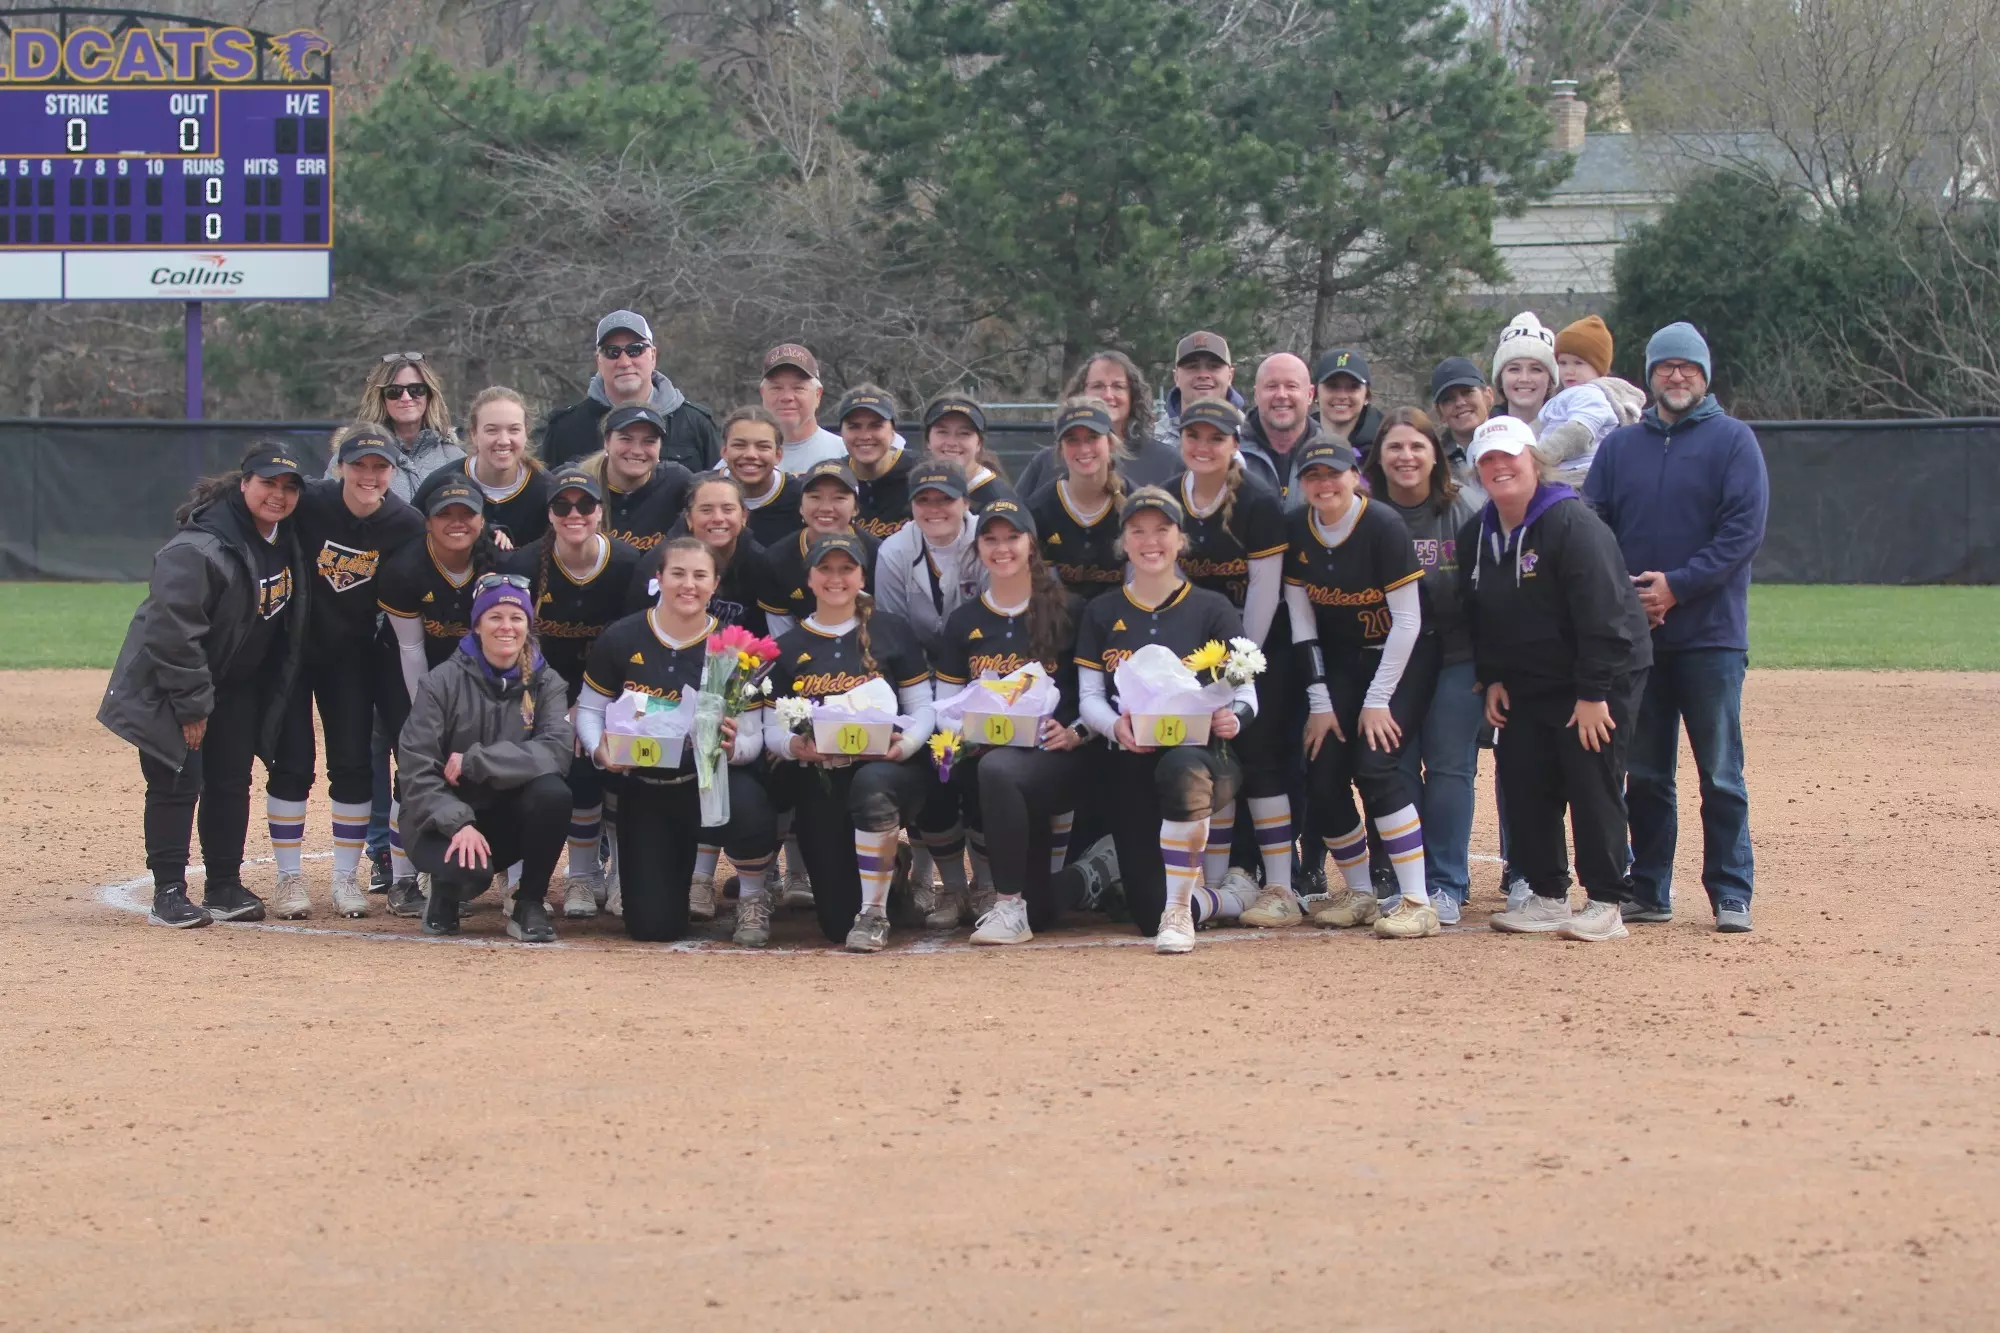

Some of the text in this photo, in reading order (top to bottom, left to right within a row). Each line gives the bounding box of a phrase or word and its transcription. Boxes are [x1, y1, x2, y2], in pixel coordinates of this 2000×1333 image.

[0, 26, 258, 82] DCATS
[46, 94, 319, 116] STRIKE OUT H/E
[67, 118, 199, 151] 0 0
[19, 159, 29, 175] 5
[42, 159, 51, 175] 6
[73, 160, 82, 174] 7
[96, 160, 105, 175] 8
[118, 160, 128, 175] 9
[146, 159, 164, 175] 10
[183, 159, 224, 175] RUNS
[244, 159, 278, 175] HITS
[296, 159, 326, 174] ERR
[206, 178, 221, 203] 0
[206, 213, 221, 239] 0
[150, 266, 245, 285] Collins
[1412, 539, 1438, 565] ES
[996, 725, 1001, 735] 3
[1167, 726, 1173, 736] 2
[641, 747, 650, 757] 10
